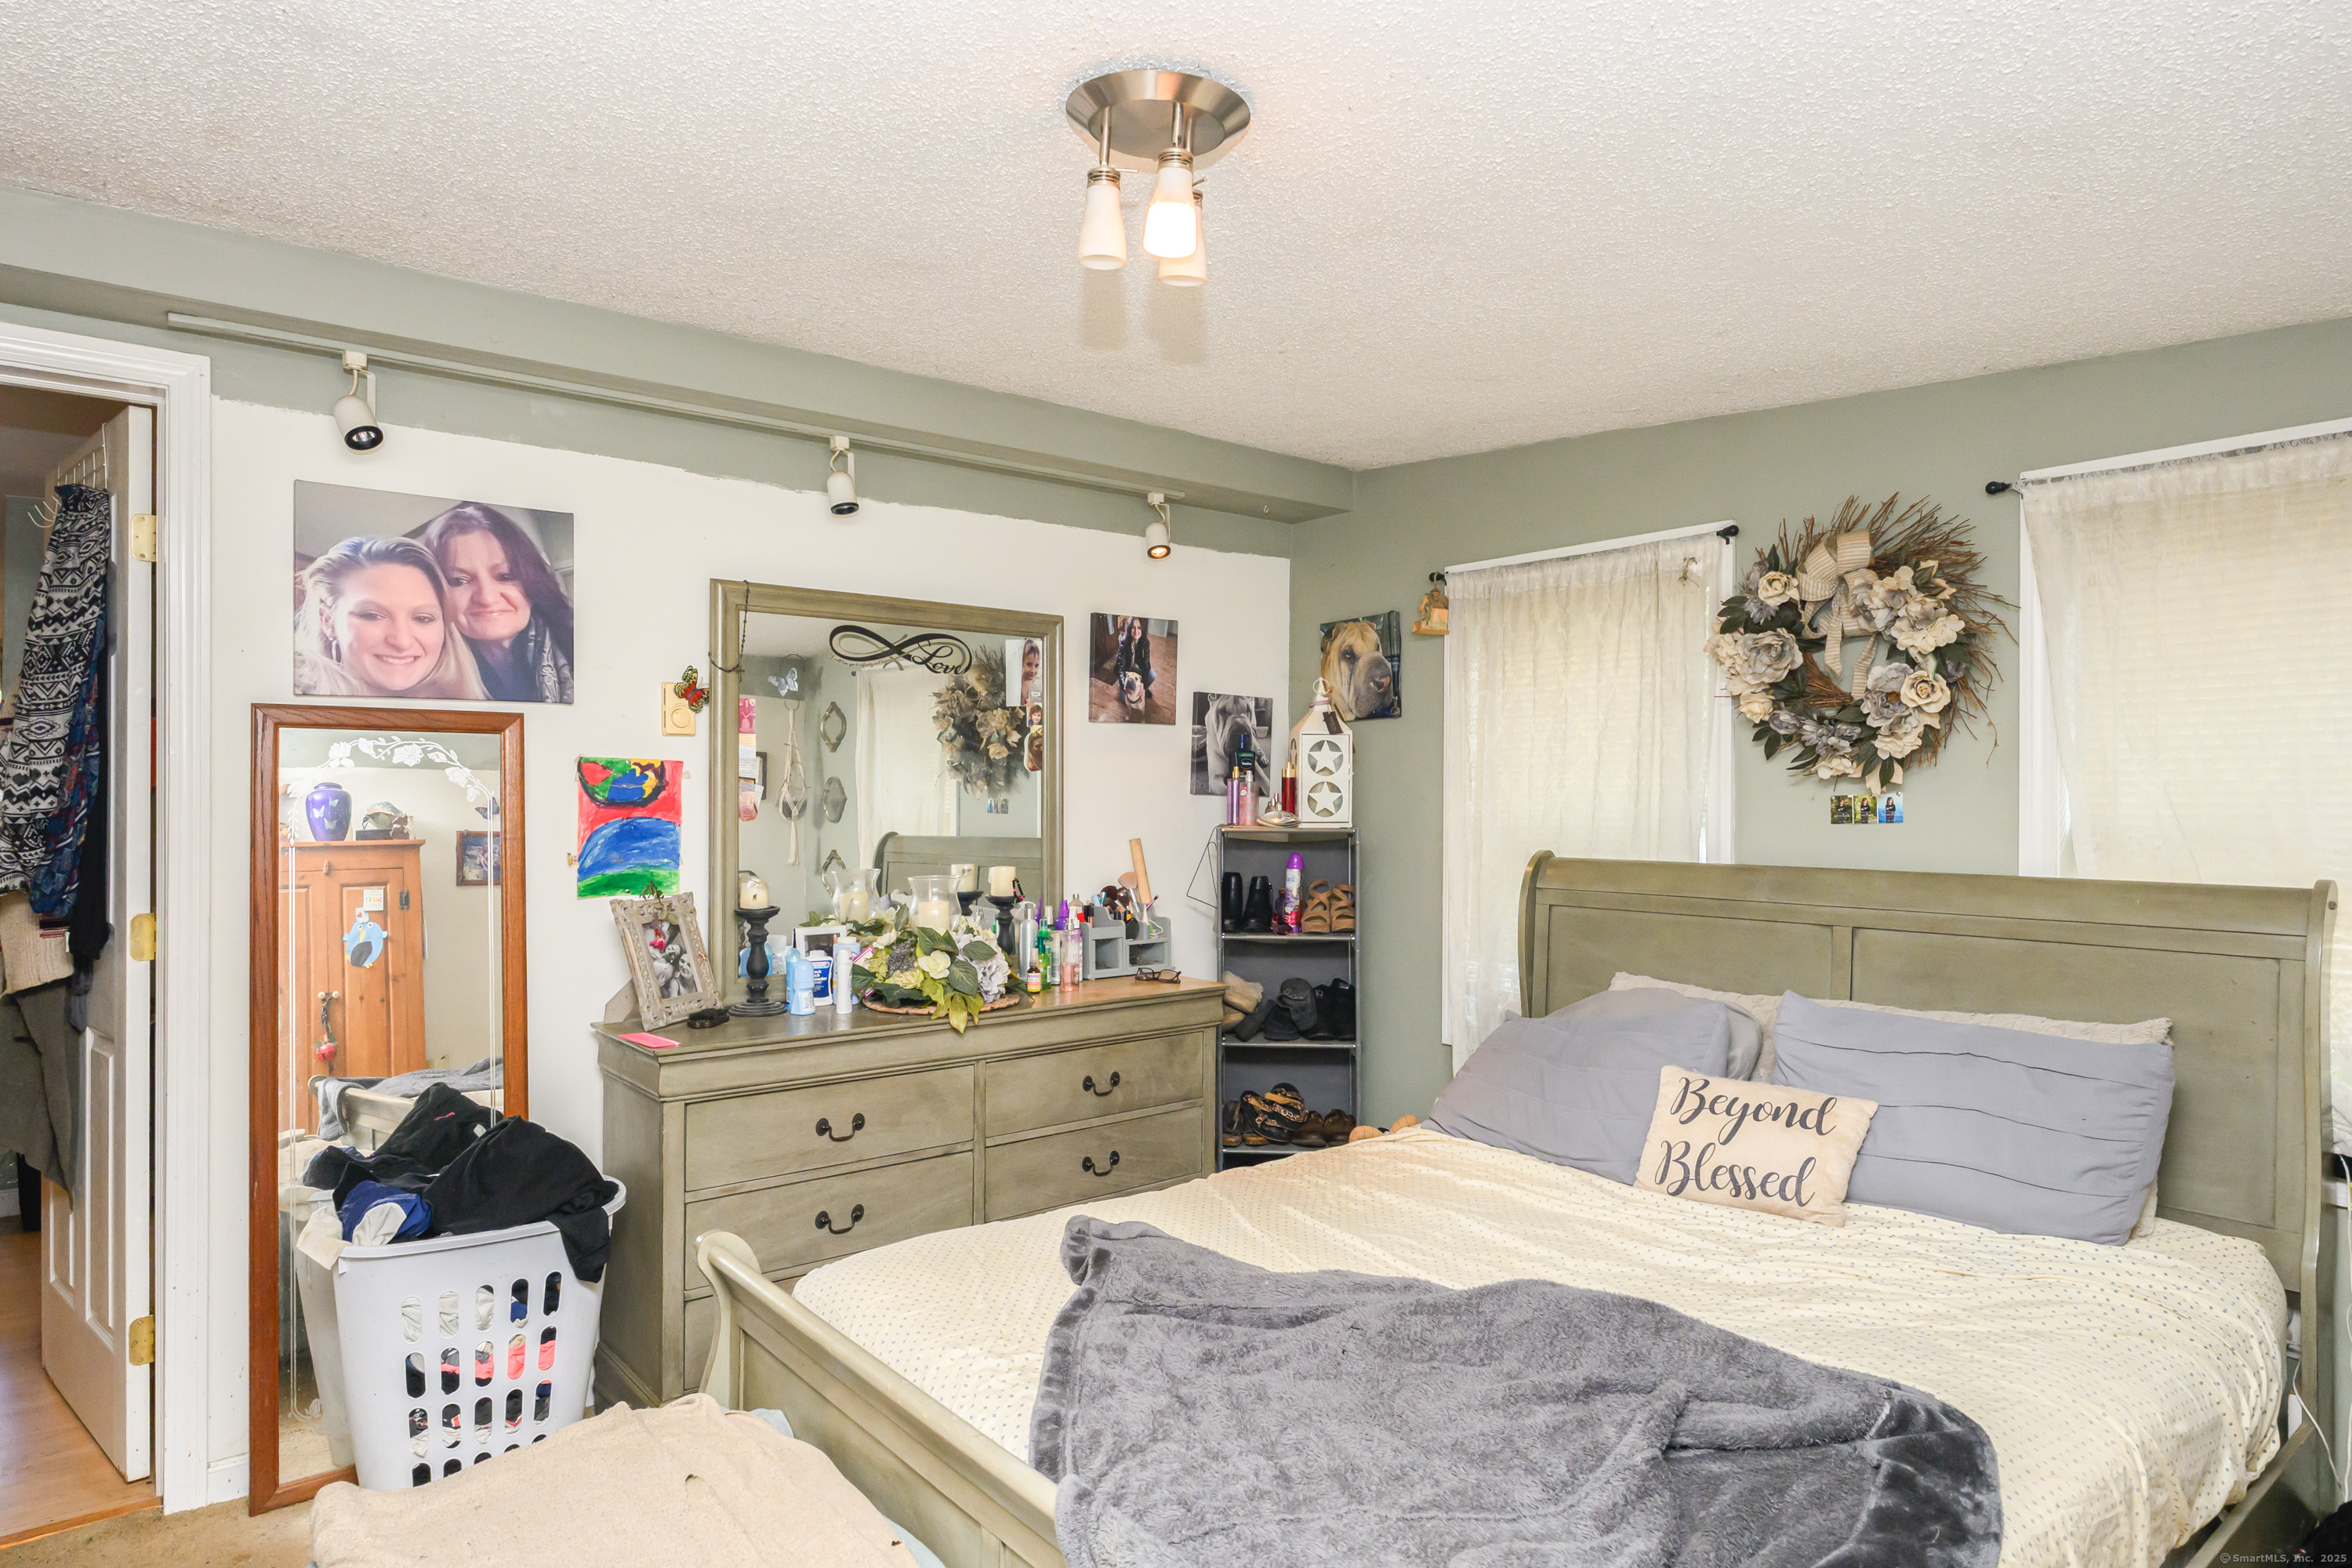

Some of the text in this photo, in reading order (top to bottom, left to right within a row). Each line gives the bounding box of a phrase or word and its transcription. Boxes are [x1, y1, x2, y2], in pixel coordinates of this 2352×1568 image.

[911, 645, 966, 675] Love
[1670, 1076, 1838, 1146] Beyond
[1654, 1140, 1817, 1207] Blessed
